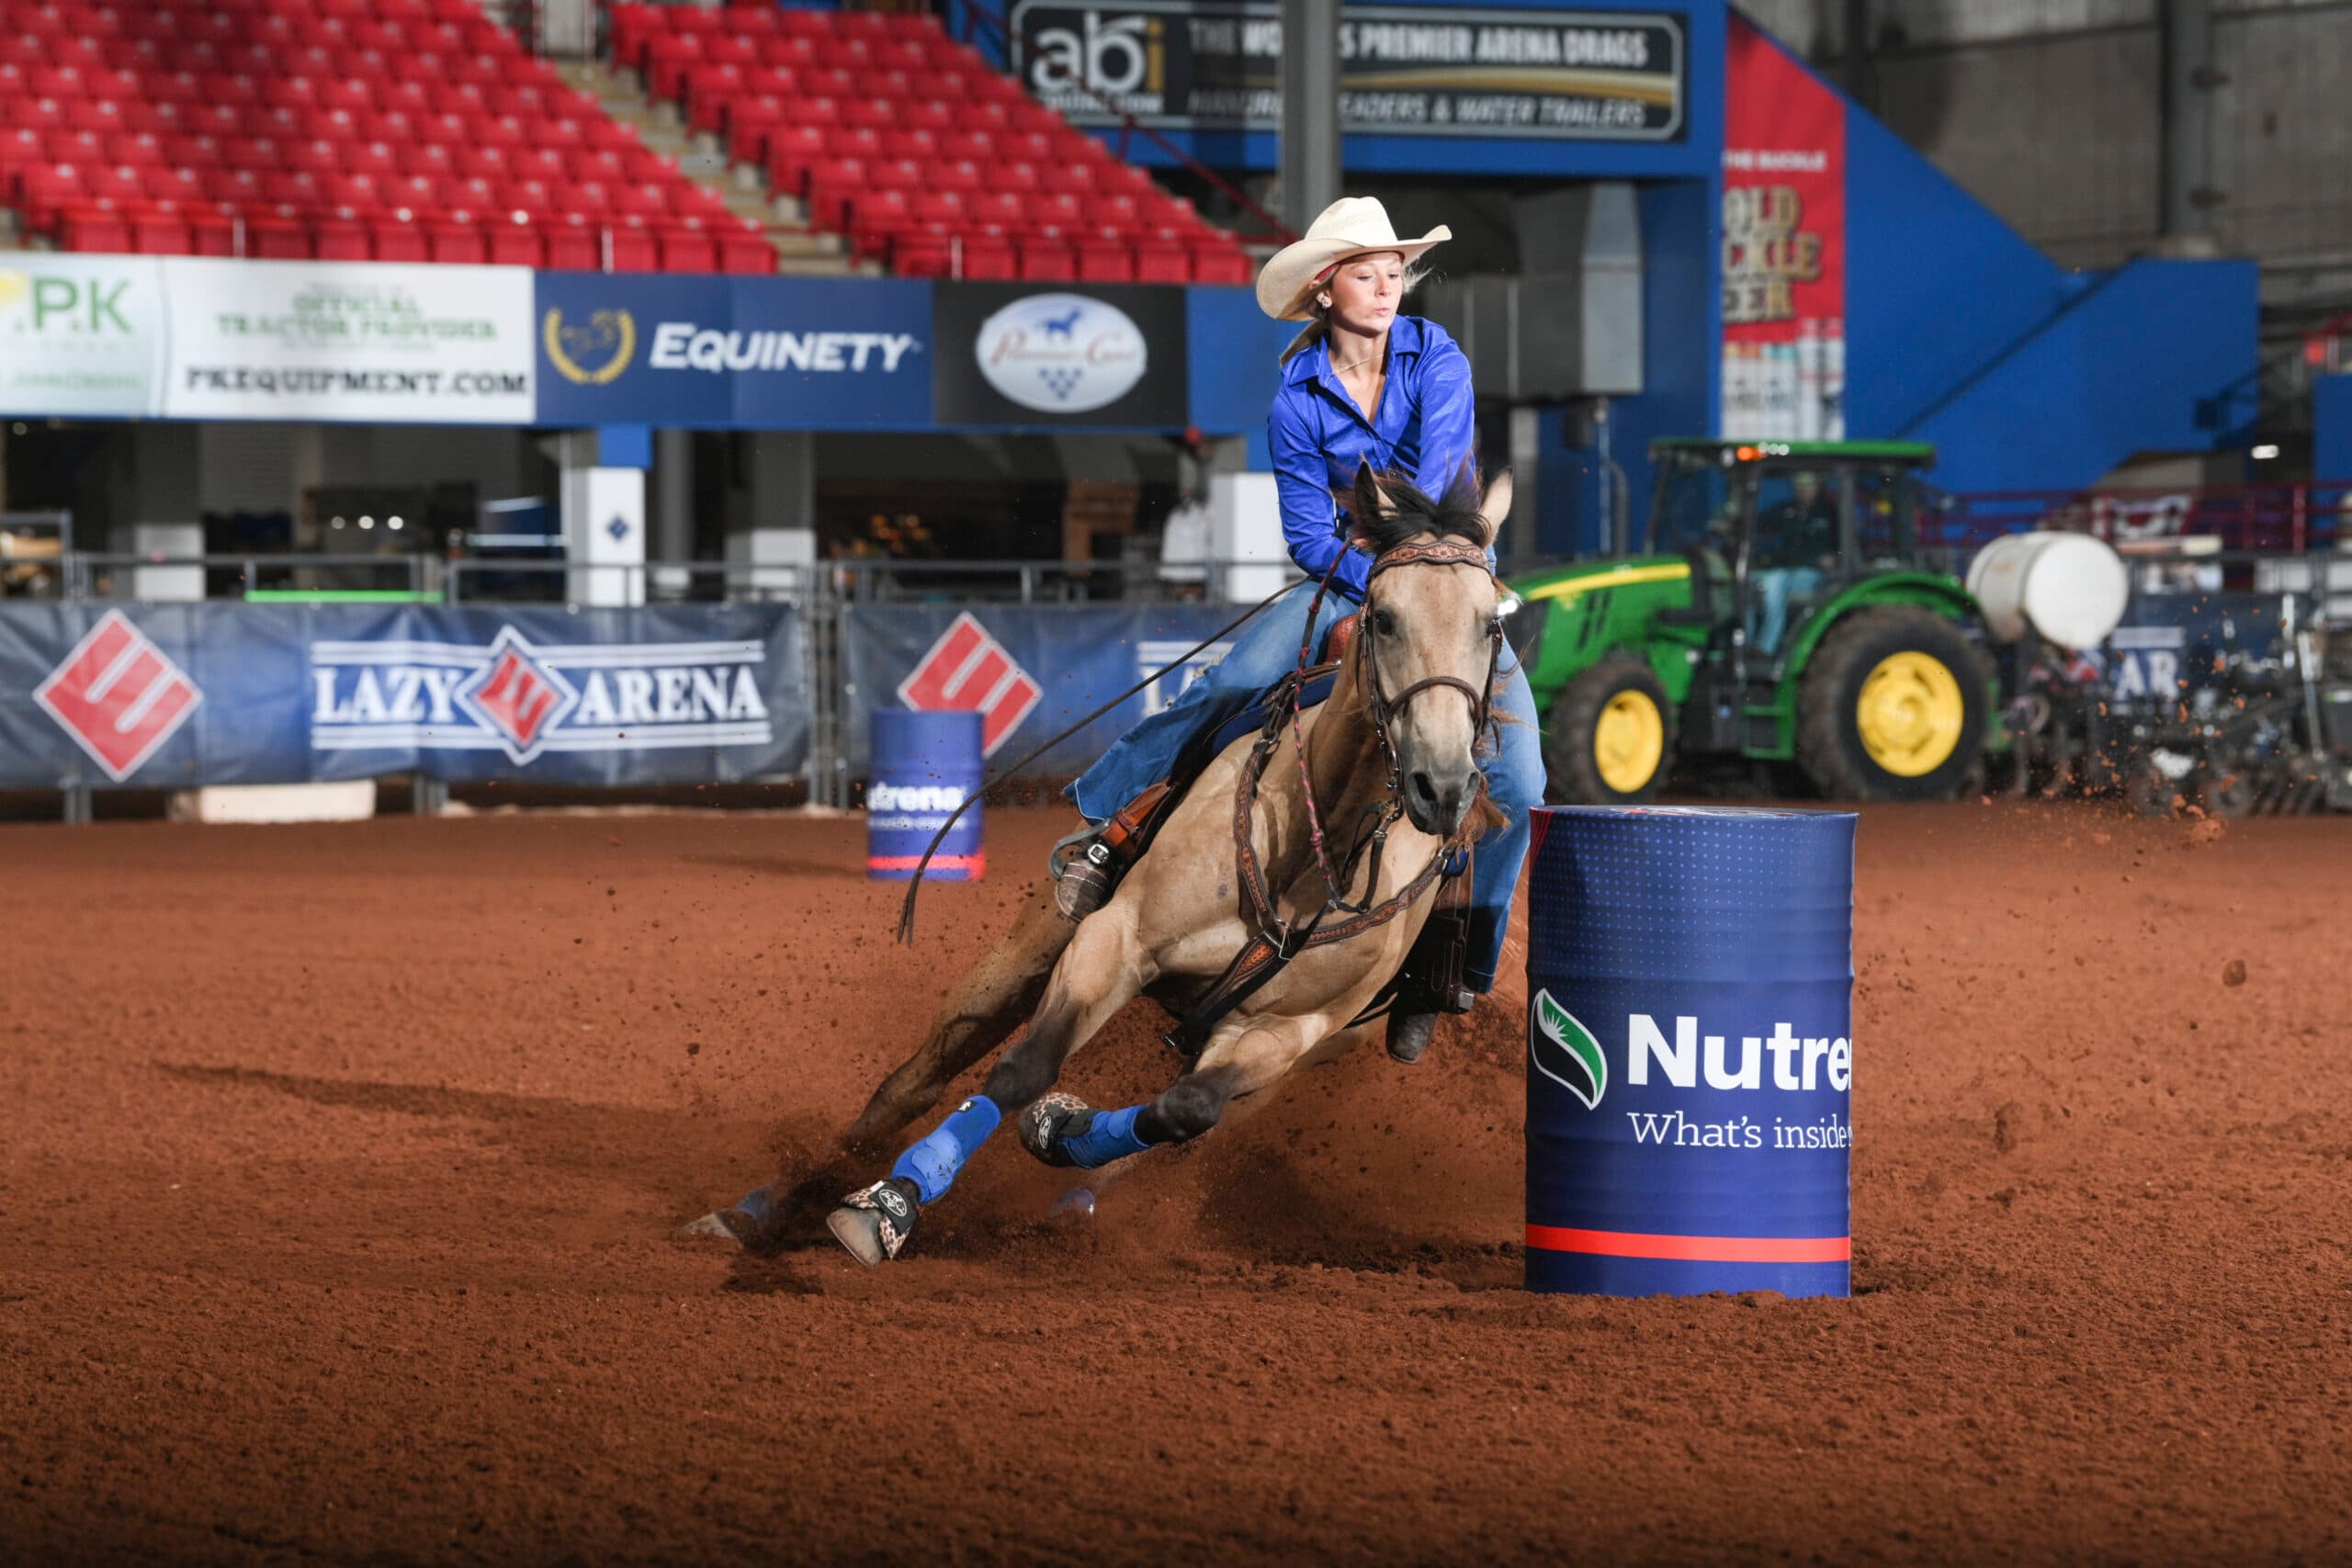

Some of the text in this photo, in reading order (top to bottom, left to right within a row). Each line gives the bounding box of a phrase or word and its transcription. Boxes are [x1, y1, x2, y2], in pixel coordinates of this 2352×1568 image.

[1031, 10, 1165, 94] abi
[1359, 25, 1472, 62] PREMIER
[1476, 27, 1561, 64] ARENA
[1564, 29, 1649, 66] DRAGS
[312, 667, 463, 723] LAZY
[573, 663, 769, 725] ARENA
[1627, 1013, 1852, 1091] Nutre
[1626, 1110, 1763, 1148] What's
